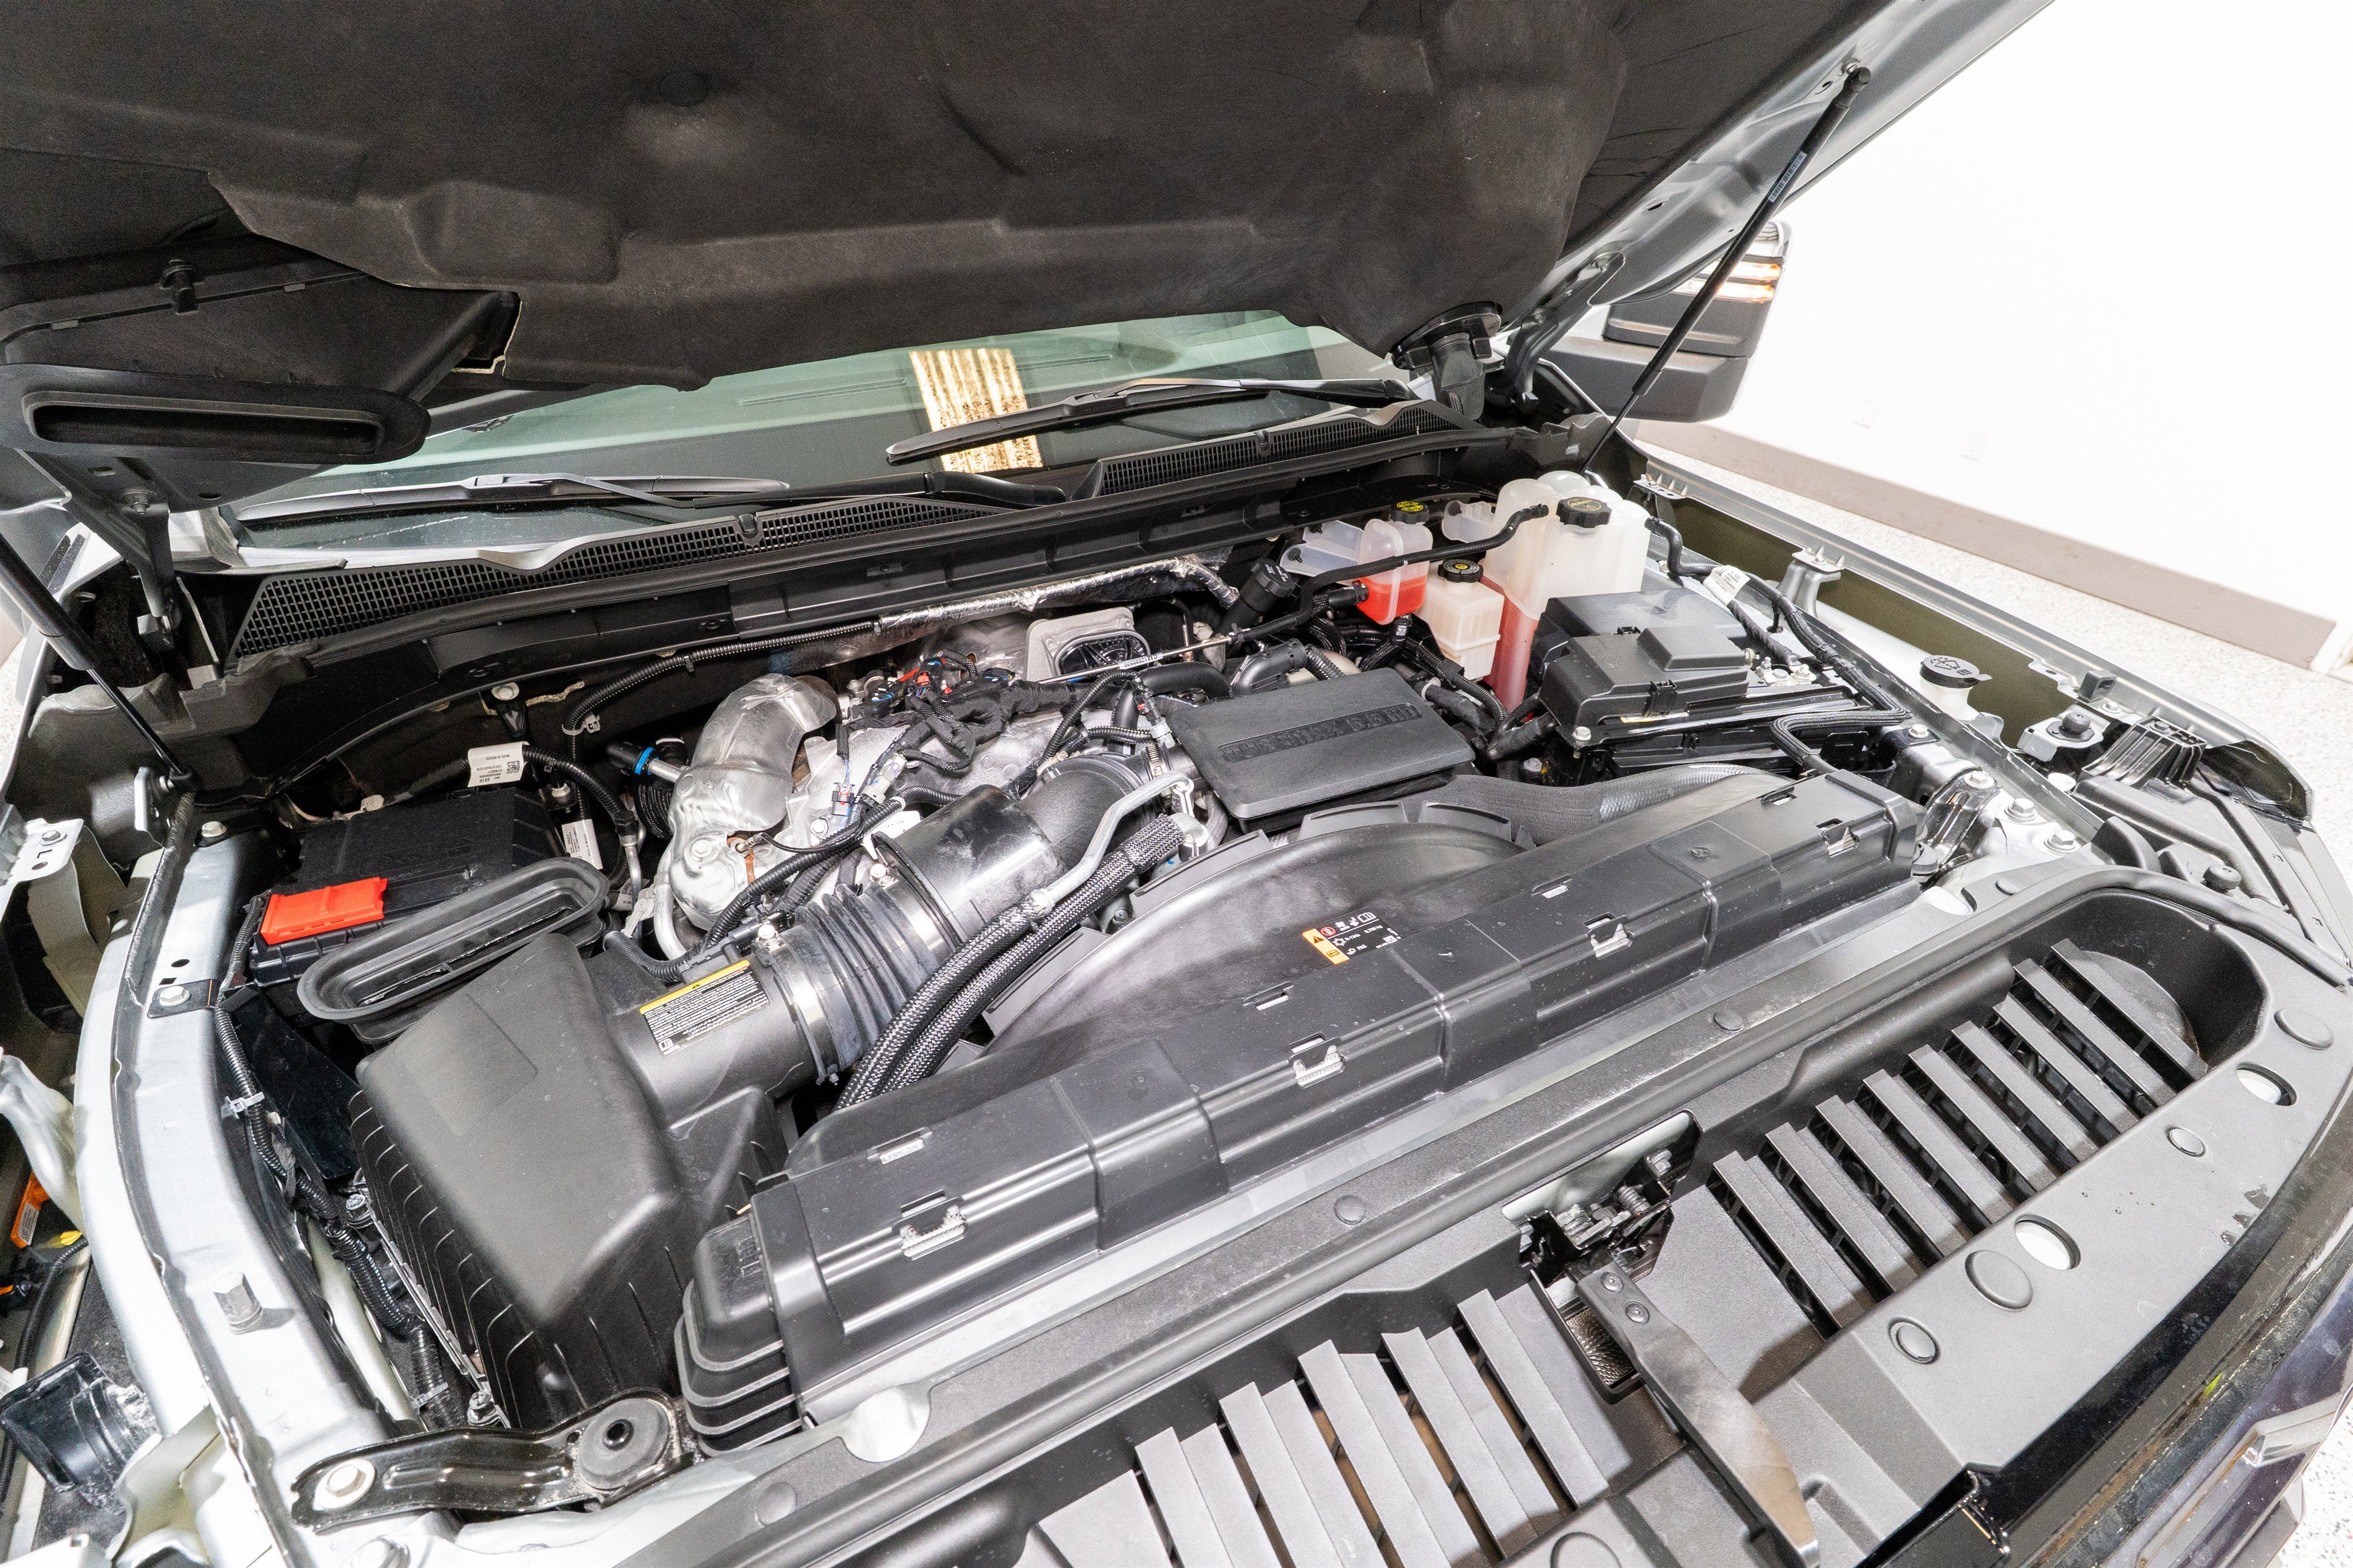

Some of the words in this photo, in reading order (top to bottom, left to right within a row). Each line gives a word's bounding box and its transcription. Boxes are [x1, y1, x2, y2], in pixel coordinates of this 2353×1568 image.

[1221, 722, 1343, 762] DURAMAX
[1345, 712, 1383, 732] 6.6
[1385, 705, 1421, 724] HD
